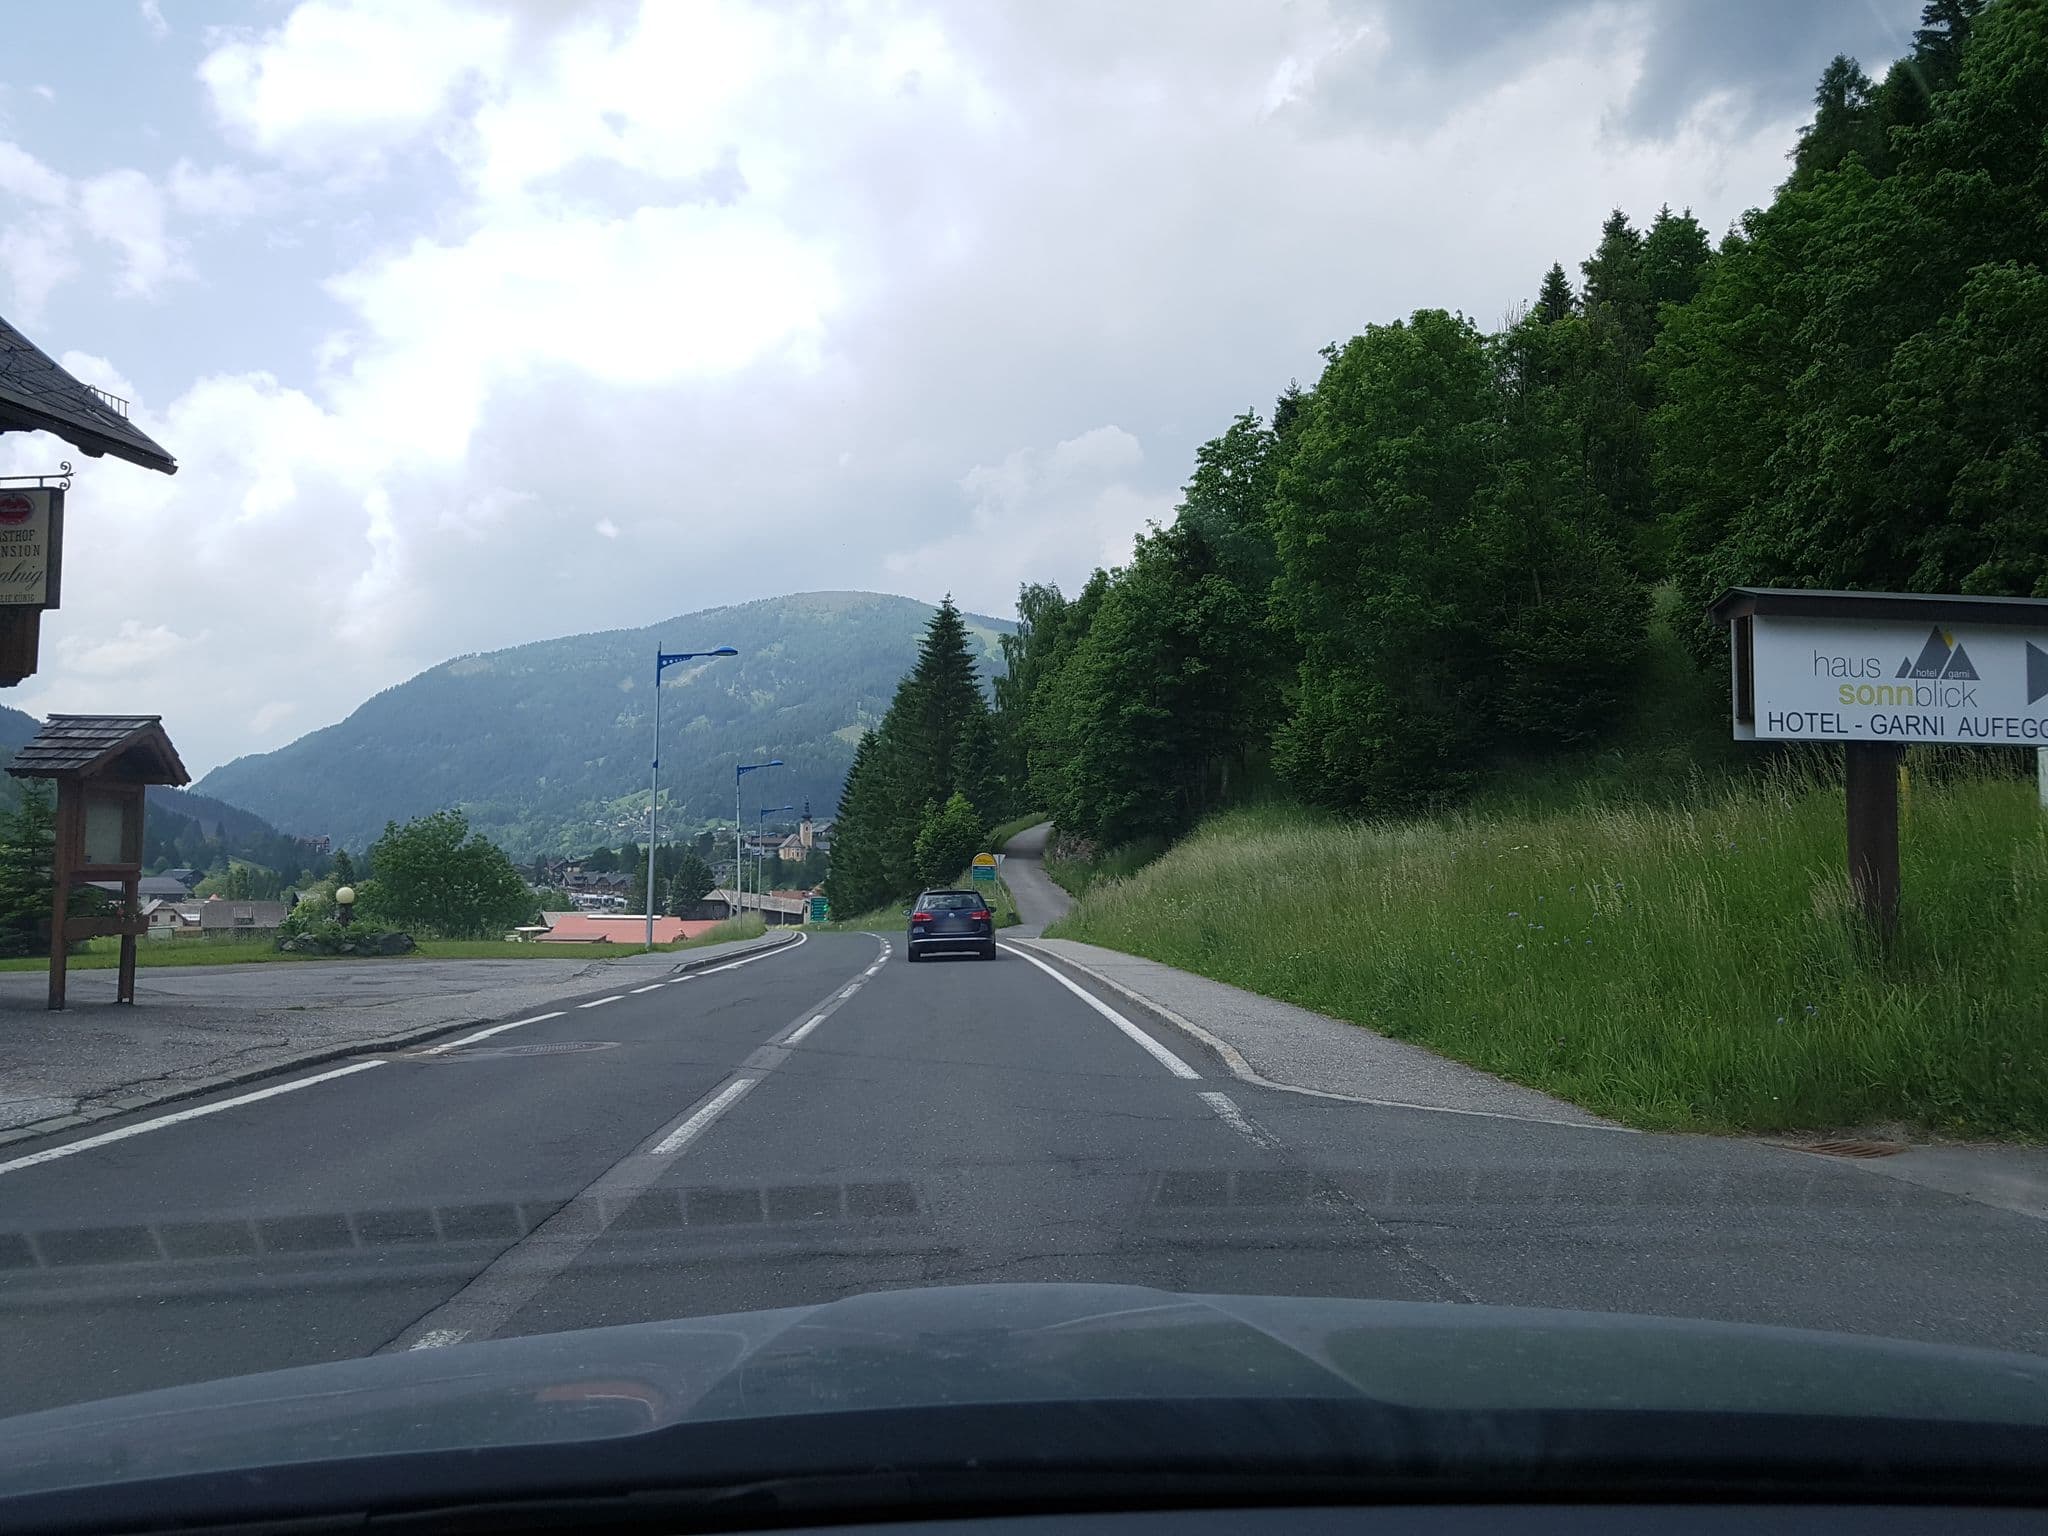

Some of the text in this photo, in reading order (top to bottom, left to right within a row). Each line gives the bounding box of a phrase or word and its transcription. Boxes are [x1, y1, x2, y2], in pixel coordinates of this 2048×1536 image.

[0, 529, 35, 542] STHOF
[1813, 649, 1881, 678] haus
[1915, 668, 1970, 679] hotel garni
[1839, 680, 1978, 708] sonnblick
[1768, 711, 1849, 734] HOTEL
[1870, 714, 1945, 736] GARNI
